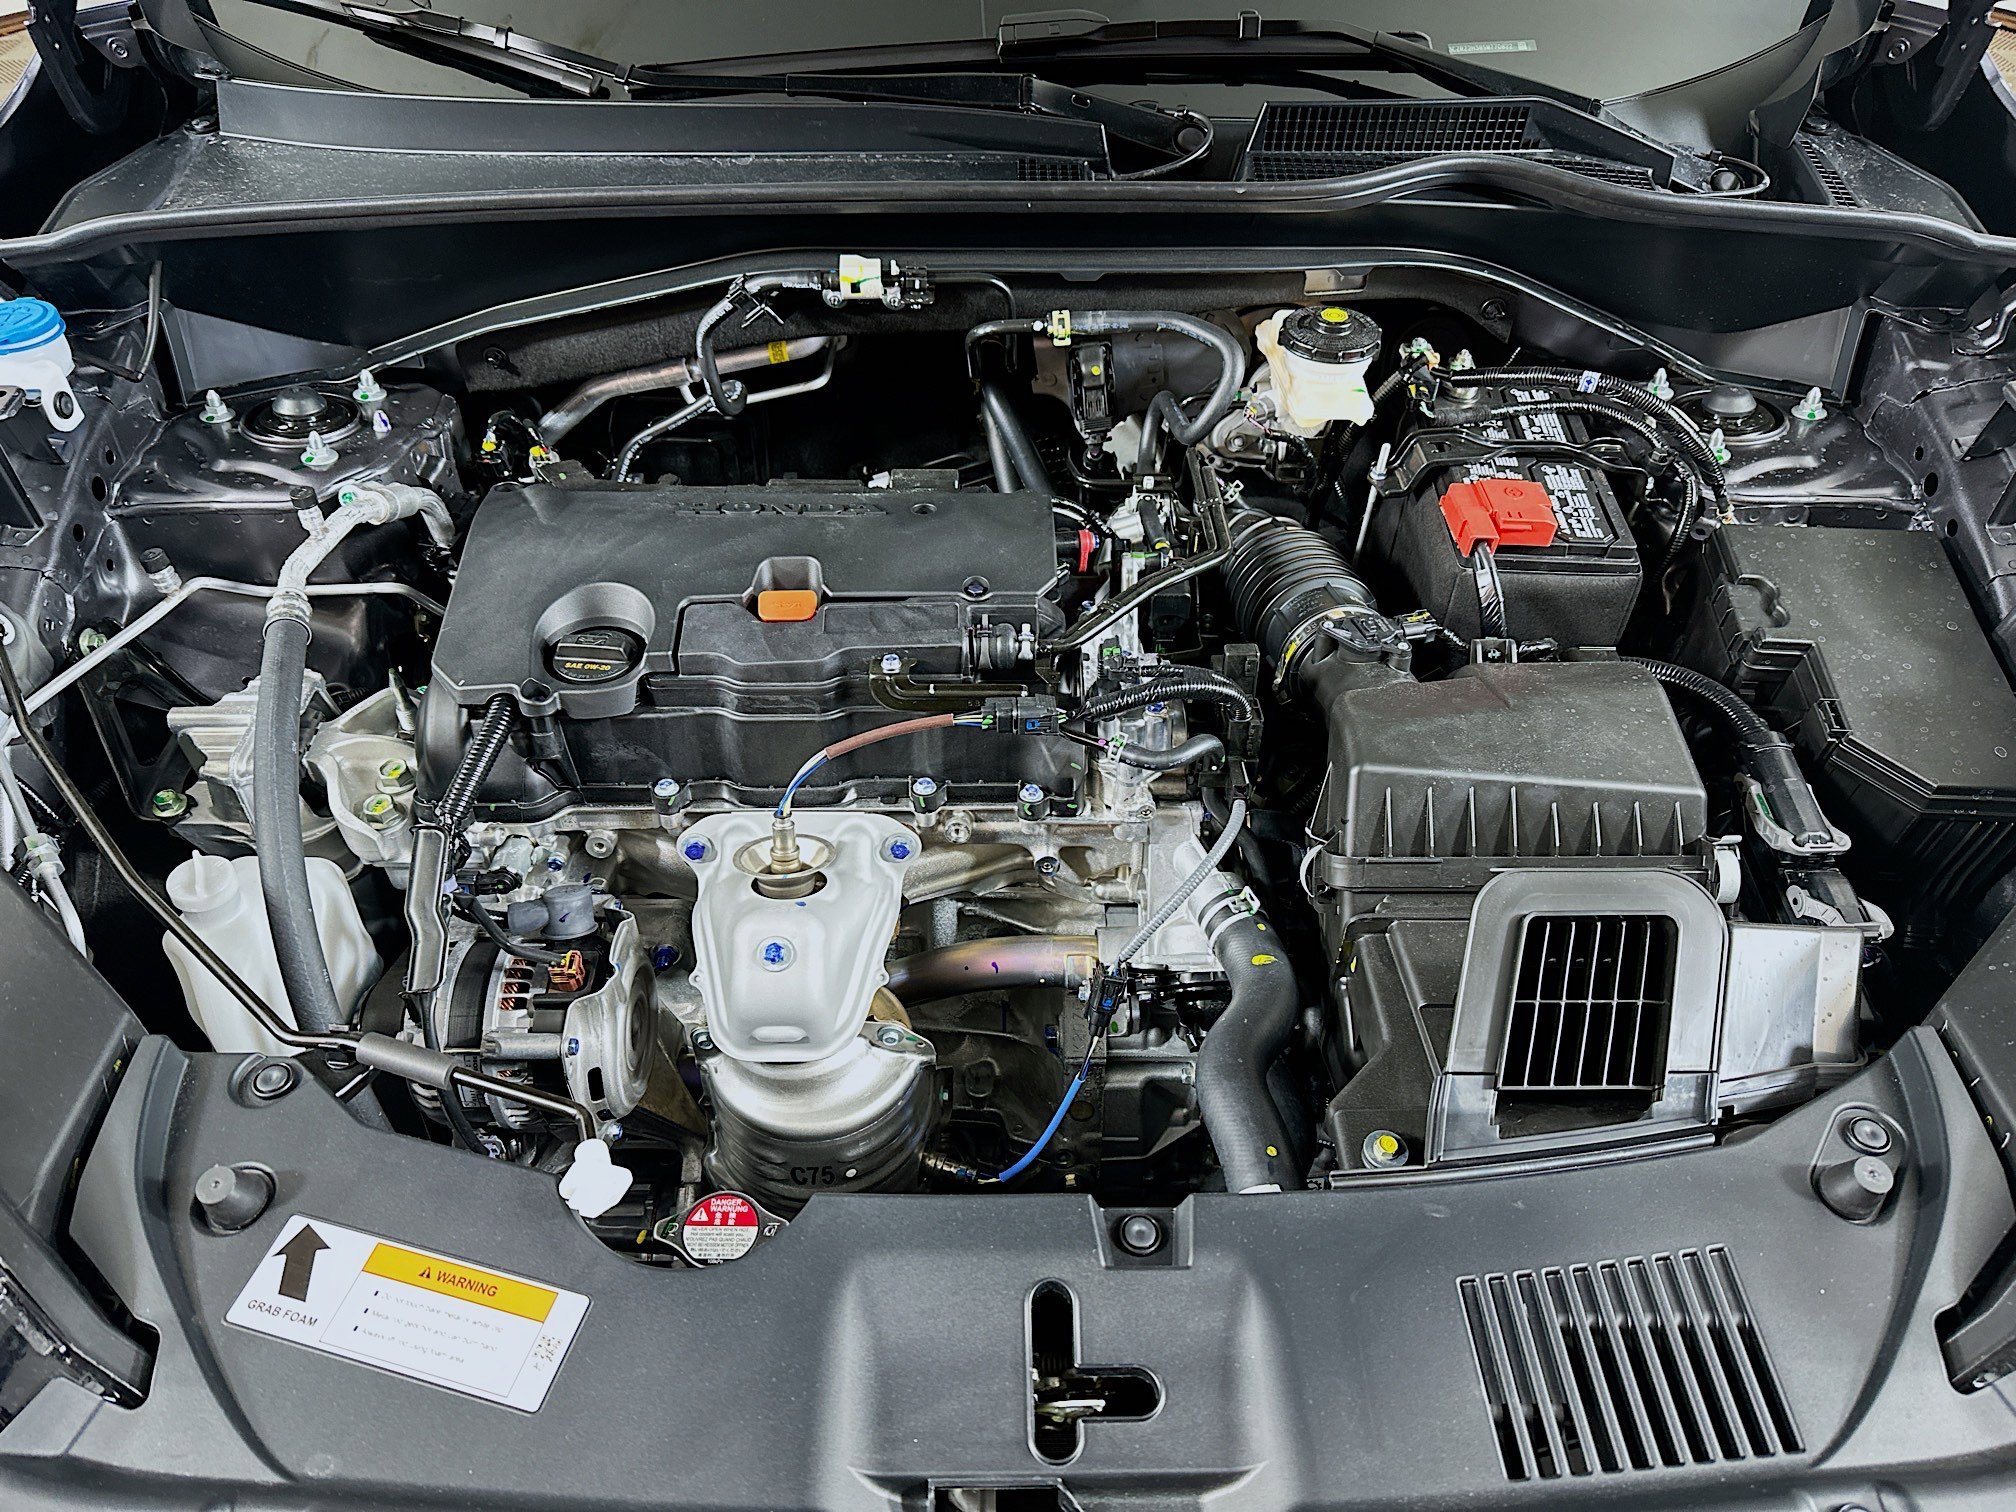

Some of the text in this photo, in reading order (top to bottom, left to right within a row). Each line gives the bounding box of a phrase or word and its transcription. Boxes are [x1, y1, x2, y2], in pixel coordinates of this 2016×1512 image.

[584, 663, 612, 671] 0W-20
[790, 1166, 836, 1185] C75
[710, 1198, 742, 1206] DANGER
[710, 1205, 748, 1213] WARNUNG
[436, 1270, 498, 1297] WARNING
[247, 1299, 318, 1326] GRAB FOAM
